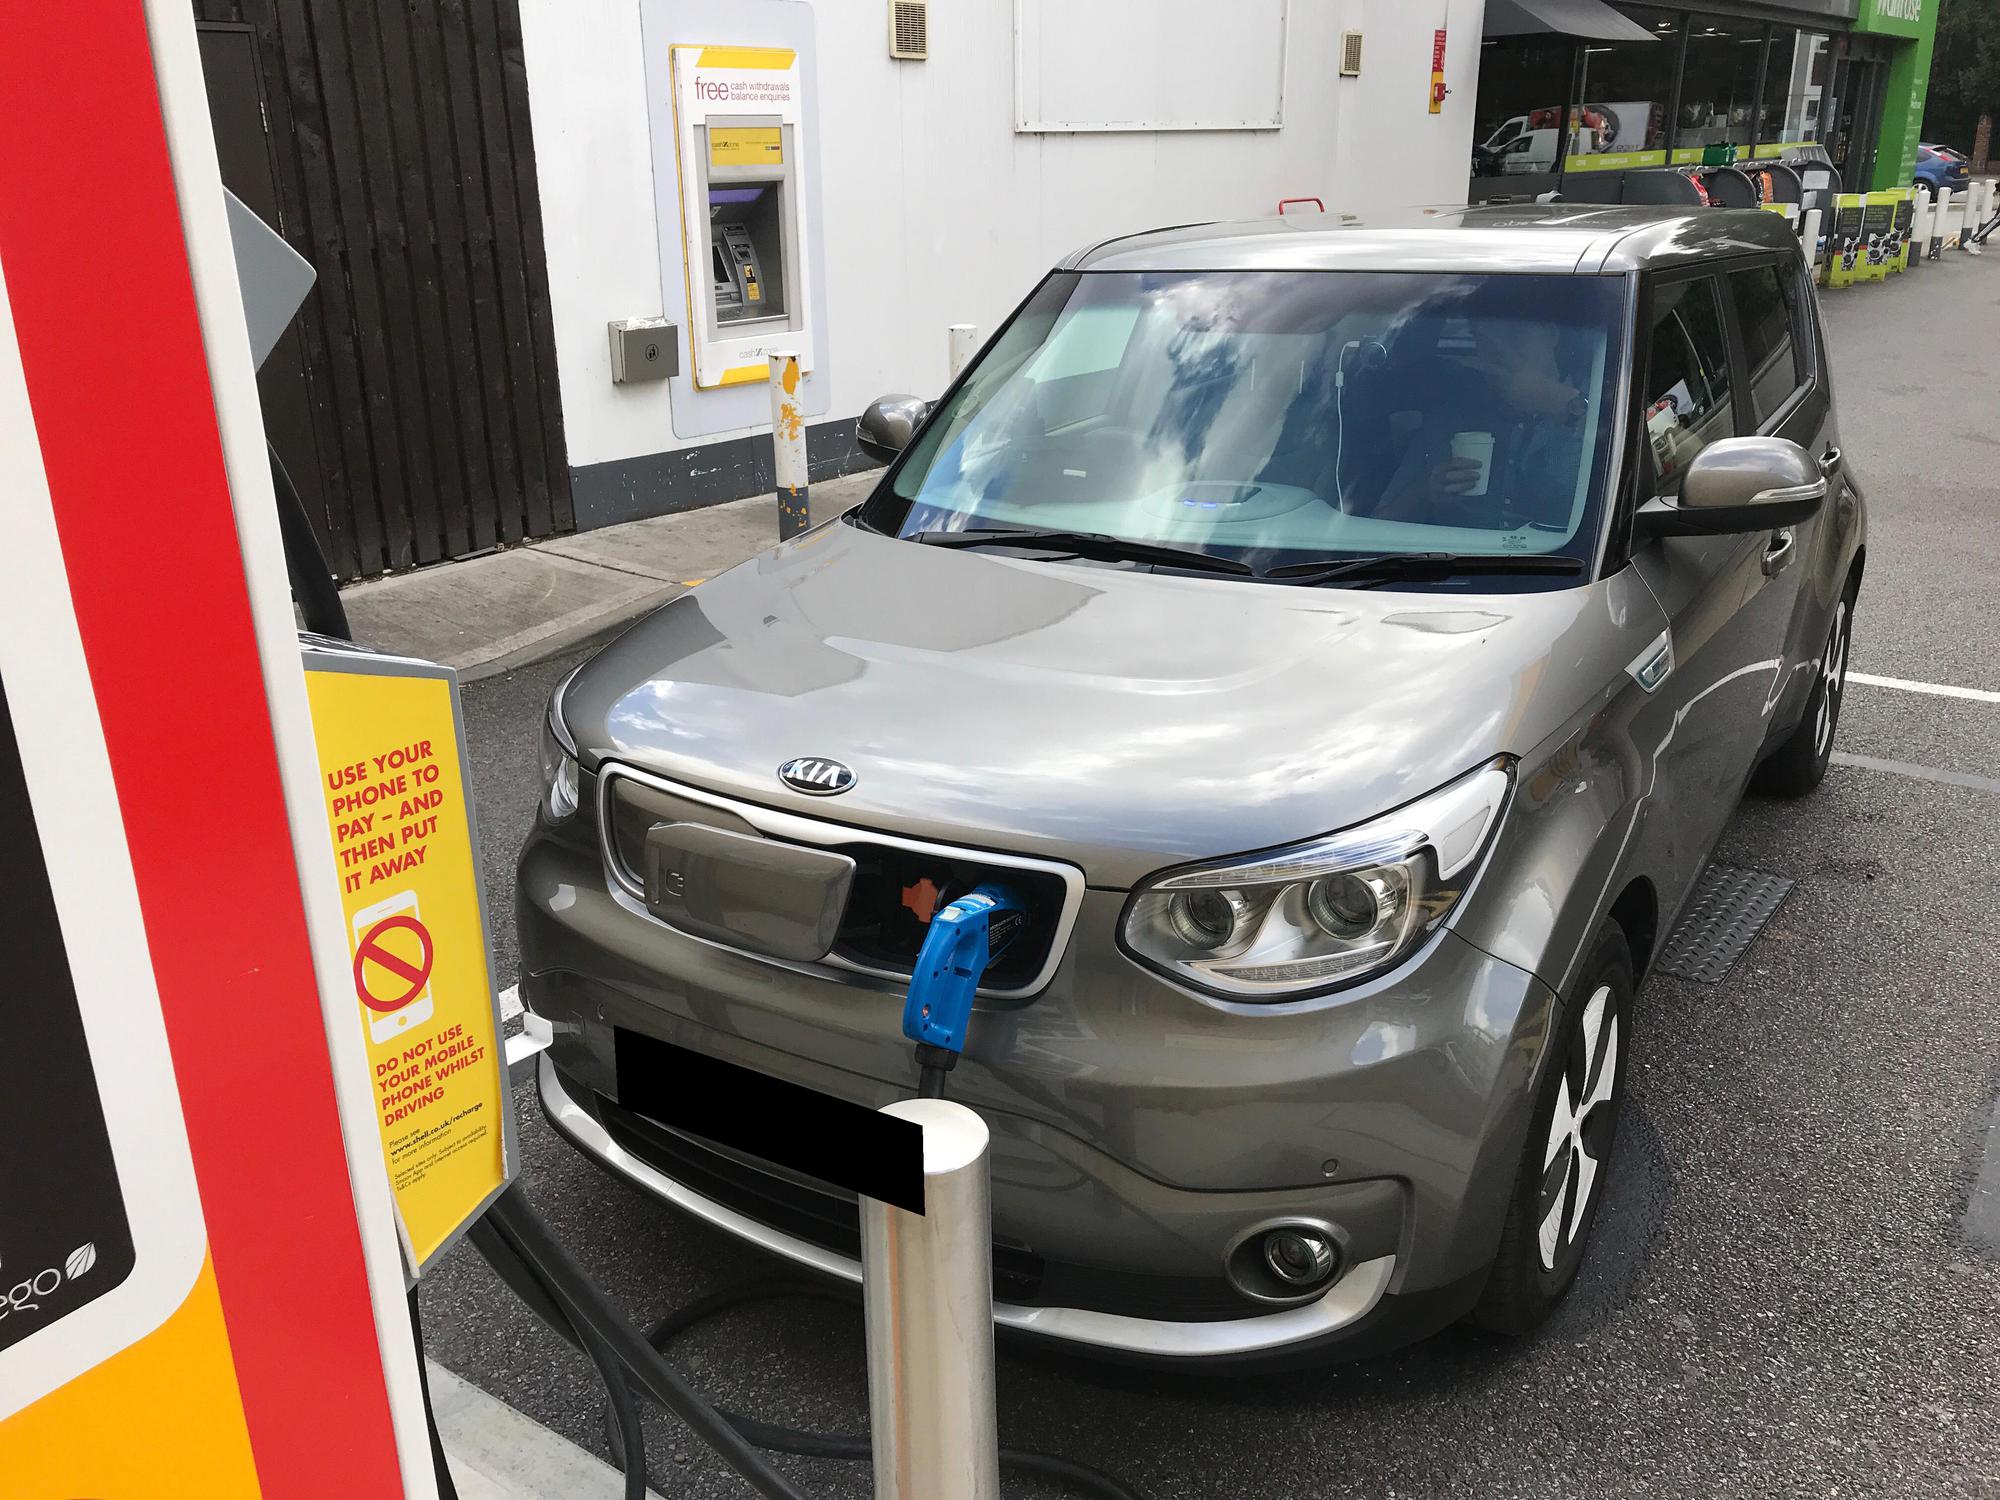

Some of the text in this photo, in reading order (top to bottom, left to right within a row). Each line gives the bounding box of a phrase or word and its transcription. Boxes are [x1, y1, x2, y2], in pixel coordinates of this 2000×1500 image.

[695, 76, 729, 101] free
[730, 82, 790, 91] cash withdrawals
[730, 92, 791, 103] balance enquiries
[328, 741, 433, 790] USE YOUR
[786, 759, 841, 788] KIA
[333, 764, 439, 817] PHONE TO
[337, 813, 374, 843] PAY
[399, 790, 443, 820] AND
[340, 816, 438, 868] THEN PUT
[345, 845, 427, 893] IT AWAY
[376, 1024, 462, 1077] DO NOT USE
[378, 1035, 475, 1093] YOUR MOBILE
[382, 1047, 485, 1110] PHONE WHILST
[384, 1087, 444, 1127] DRIVING
[390, 1102, 483, 1156] www.shell.co.uk/recharge
[389, 1128, 420, 1148] Please see
[402, 1148, 417, 1160] more
[419, 1129, 452, 1149] information
